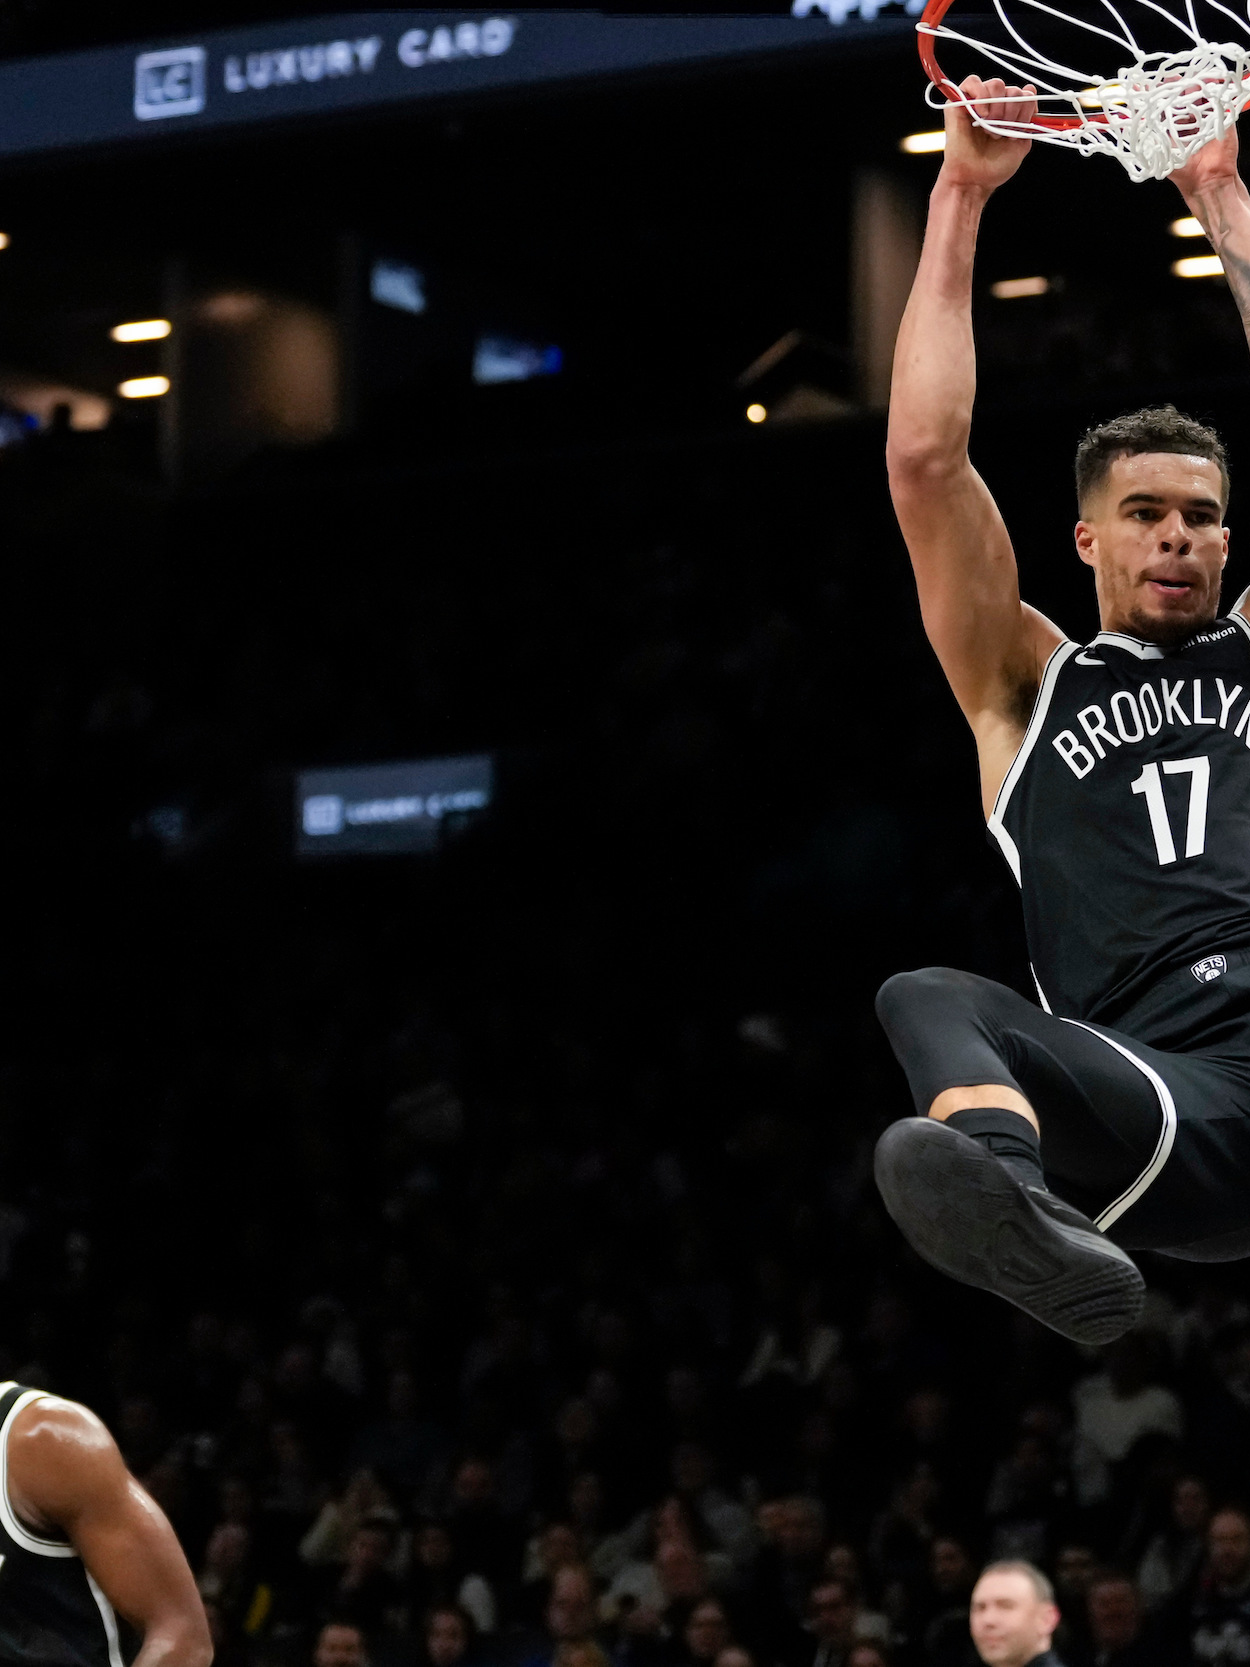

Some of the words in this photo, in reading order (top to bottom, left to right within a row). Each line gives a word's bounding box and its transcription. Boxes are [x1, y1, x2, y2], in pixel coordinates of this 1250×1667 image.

[223, 35, 382, 93] LUXURY
[398, 17, 516, 68] CARD
[1130, 755, 1211, 866] 17
[1194, 957, 1224, 977] NETS
